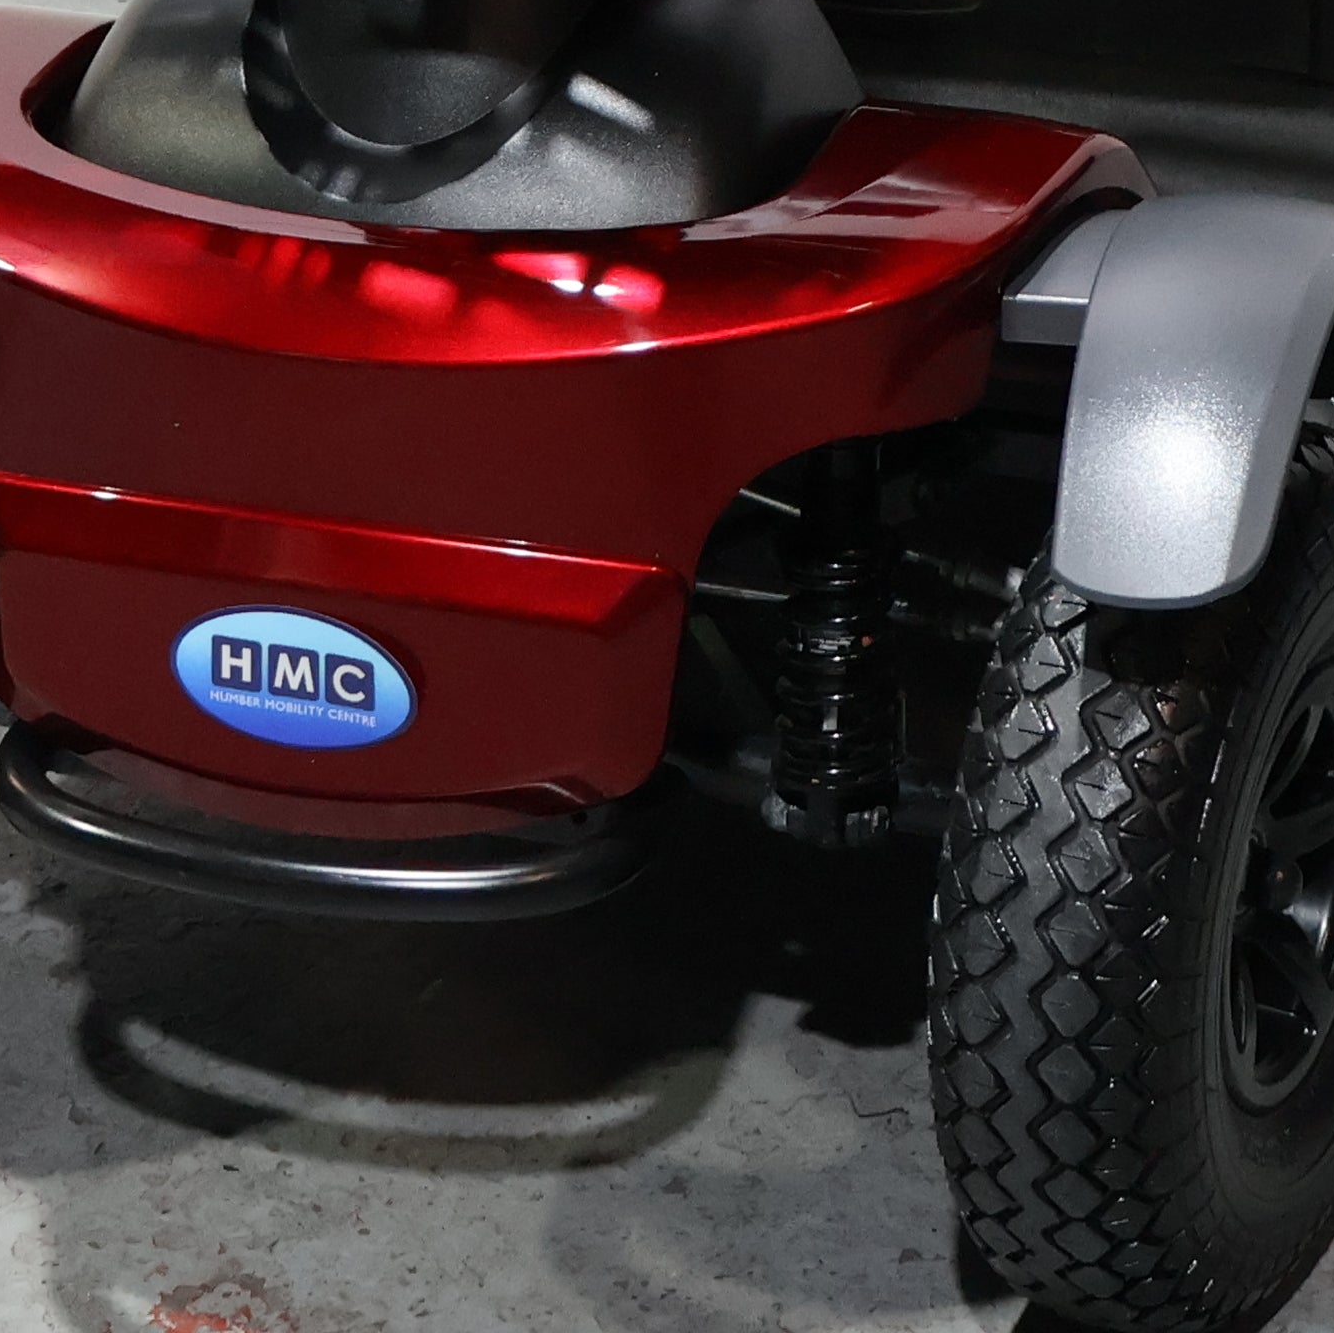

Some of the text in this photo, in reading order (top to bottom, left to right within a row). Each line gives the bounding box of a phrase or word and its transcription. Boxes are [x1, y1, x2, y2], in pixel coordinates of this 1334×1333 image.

[221, 644, 366, 703] HMC
[210, 690, 376, 728] HUMBER MOBILITY CENTRE
